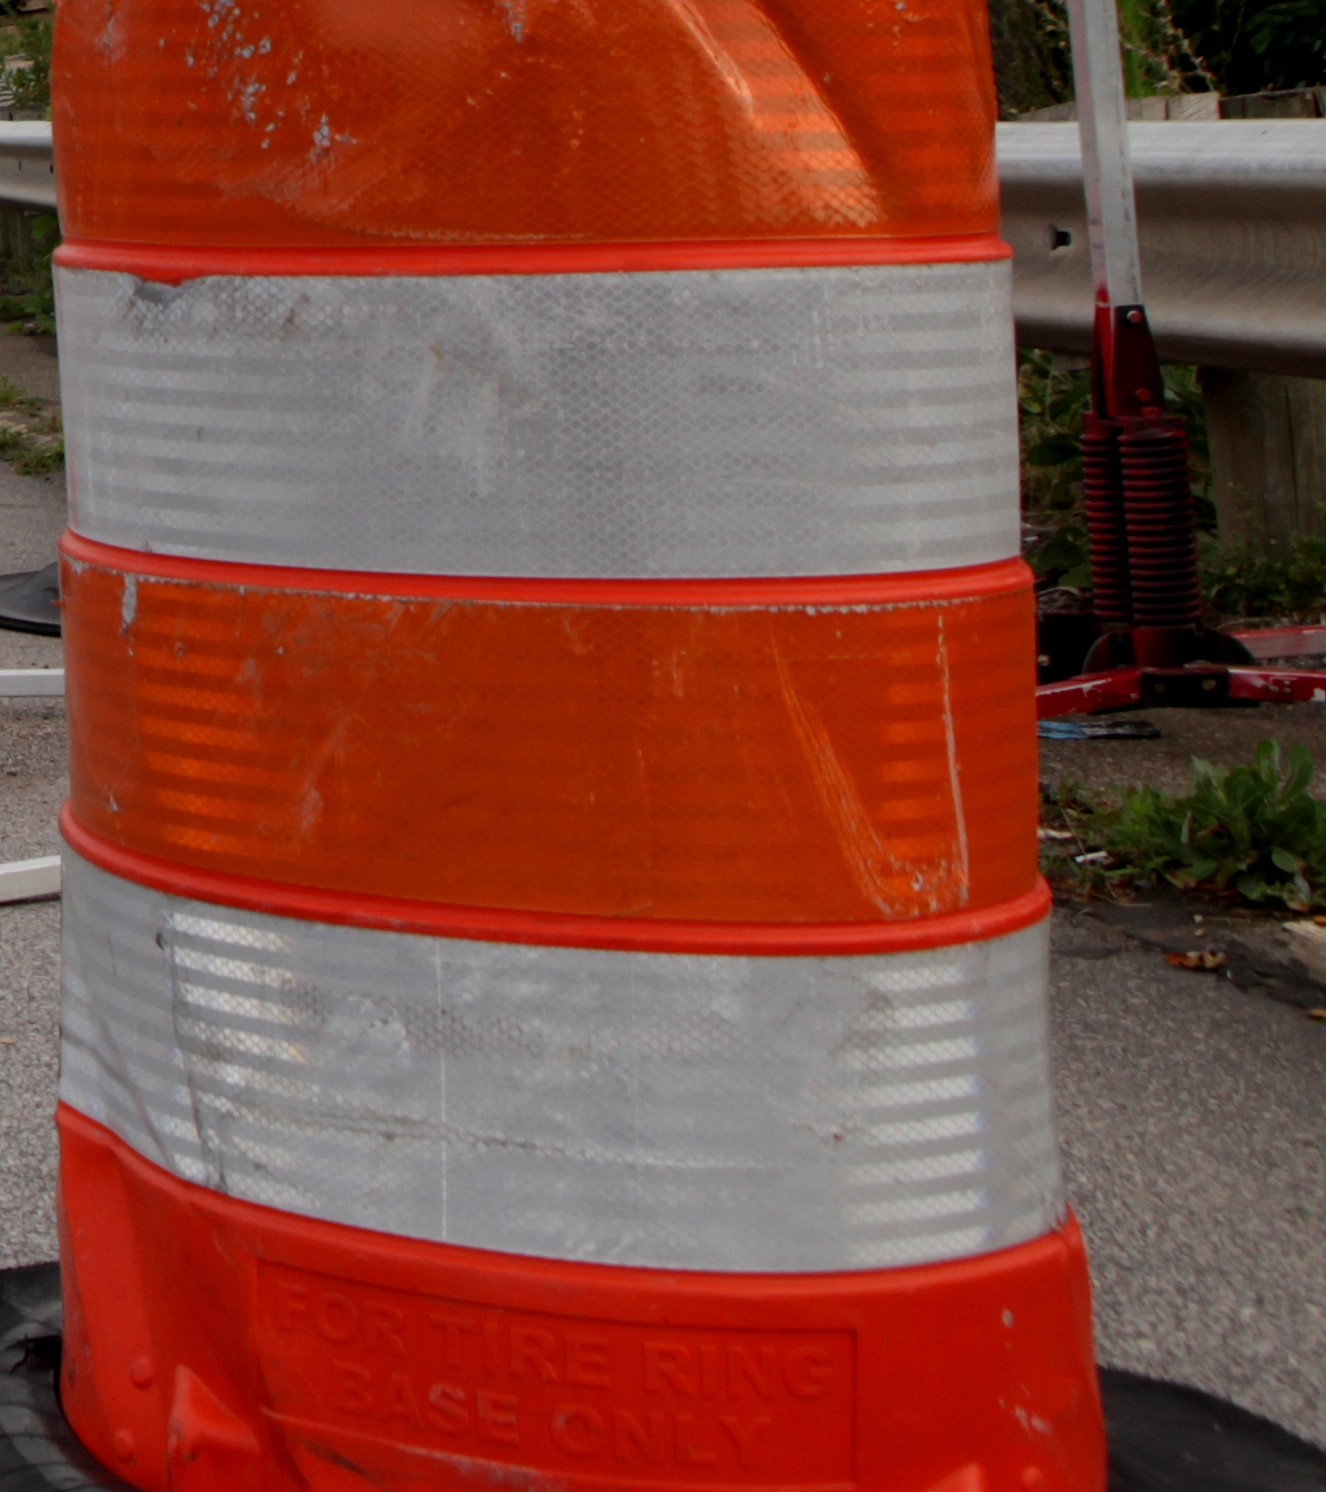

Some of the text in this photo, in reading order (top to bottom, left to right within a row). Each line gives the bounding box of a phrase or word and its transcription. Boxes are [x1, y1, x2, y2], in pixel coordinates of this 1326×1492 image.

[276, 1279, 836, 1401] FOR TIRE RING
[325, 1358, 772, 1472] BASE ONLY
